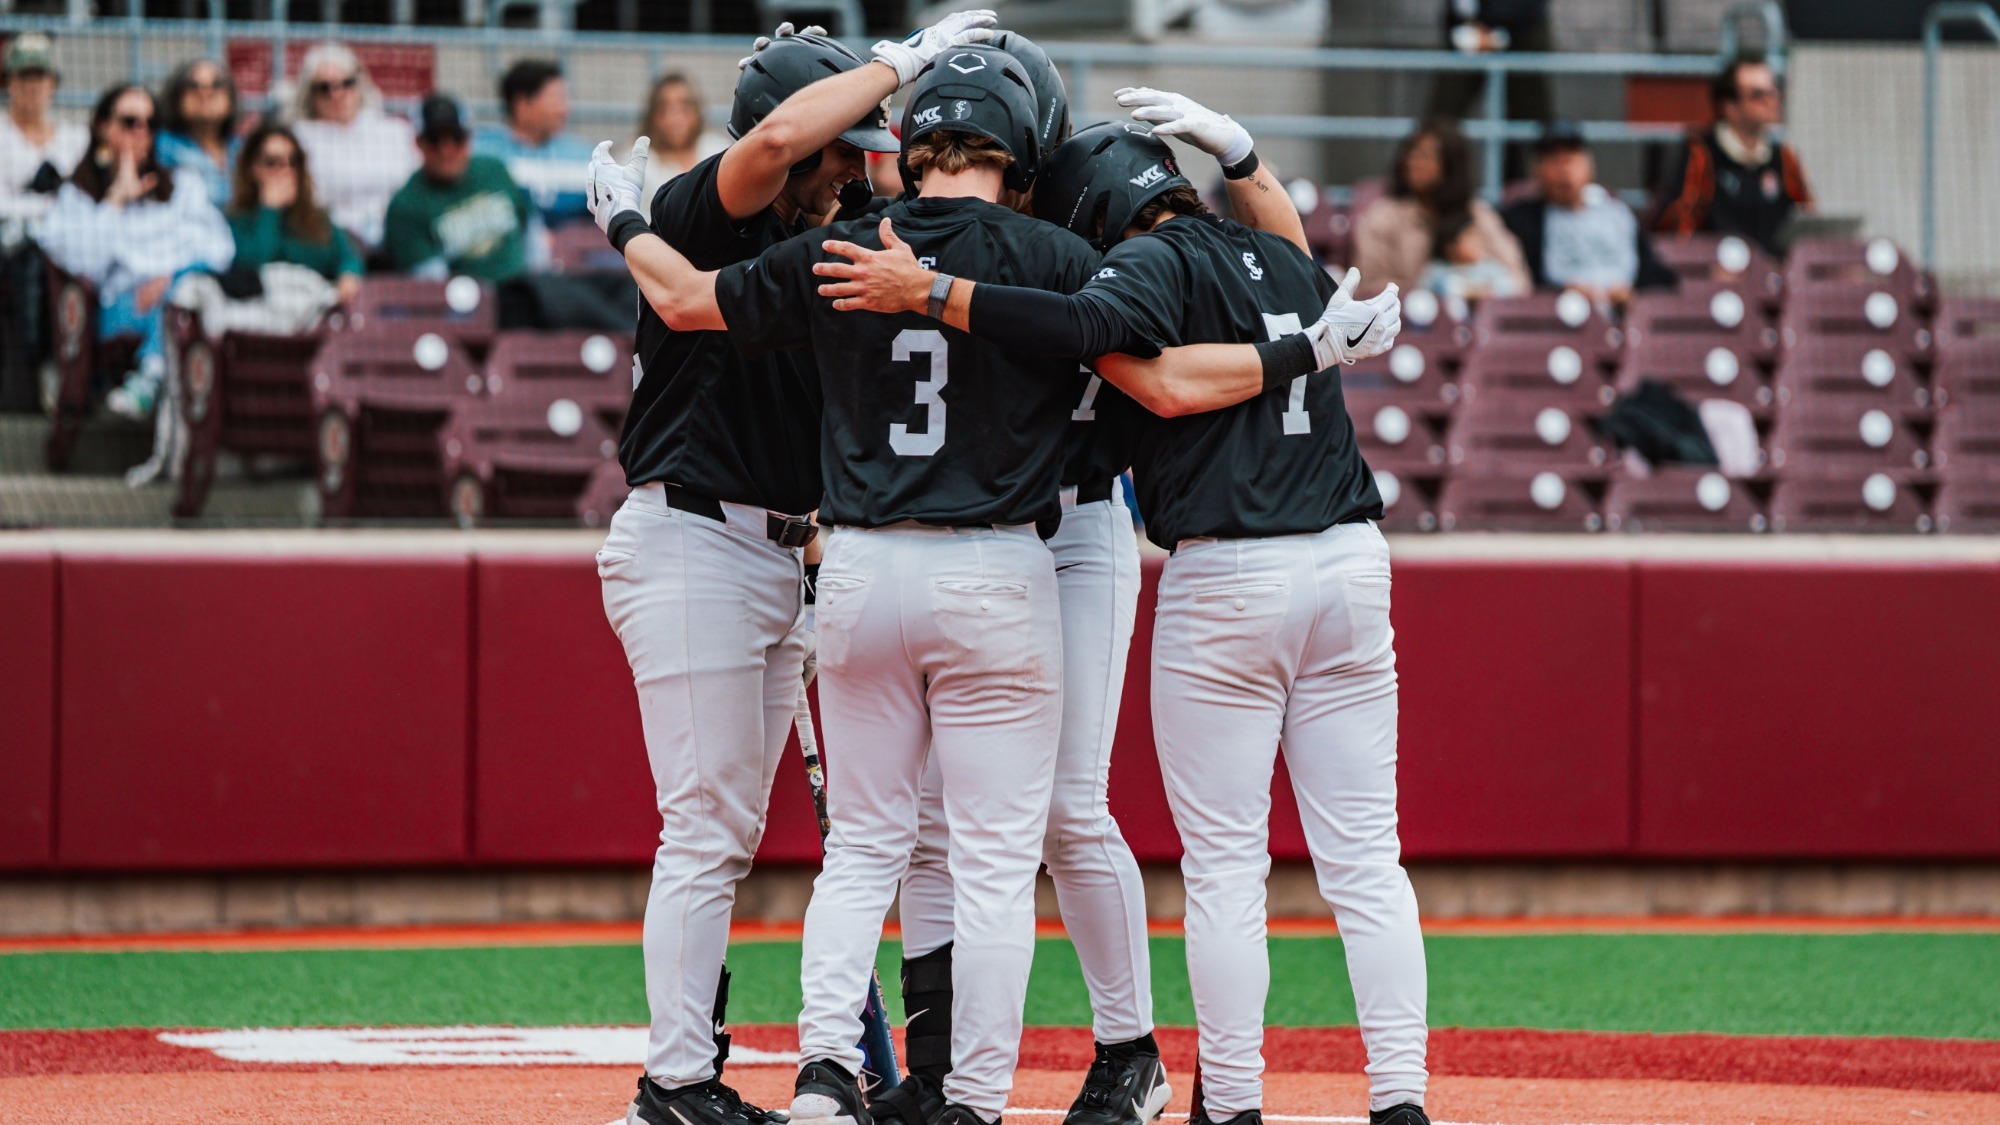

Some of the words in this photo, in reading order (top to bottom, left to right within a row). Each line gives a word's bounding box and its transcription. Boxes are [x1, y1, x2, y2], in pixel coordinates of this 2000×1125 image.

[912, 105, 943, 126] WCC
[1043, 97, 1057, 139] EVOSHIELD
[1129, 164, 1165, 188] WCC
[1067, 186, 1088, 229] EVOSHIELD
[889, 328, 949, 456] 3
[1261, 312, 1311, 435] 7
